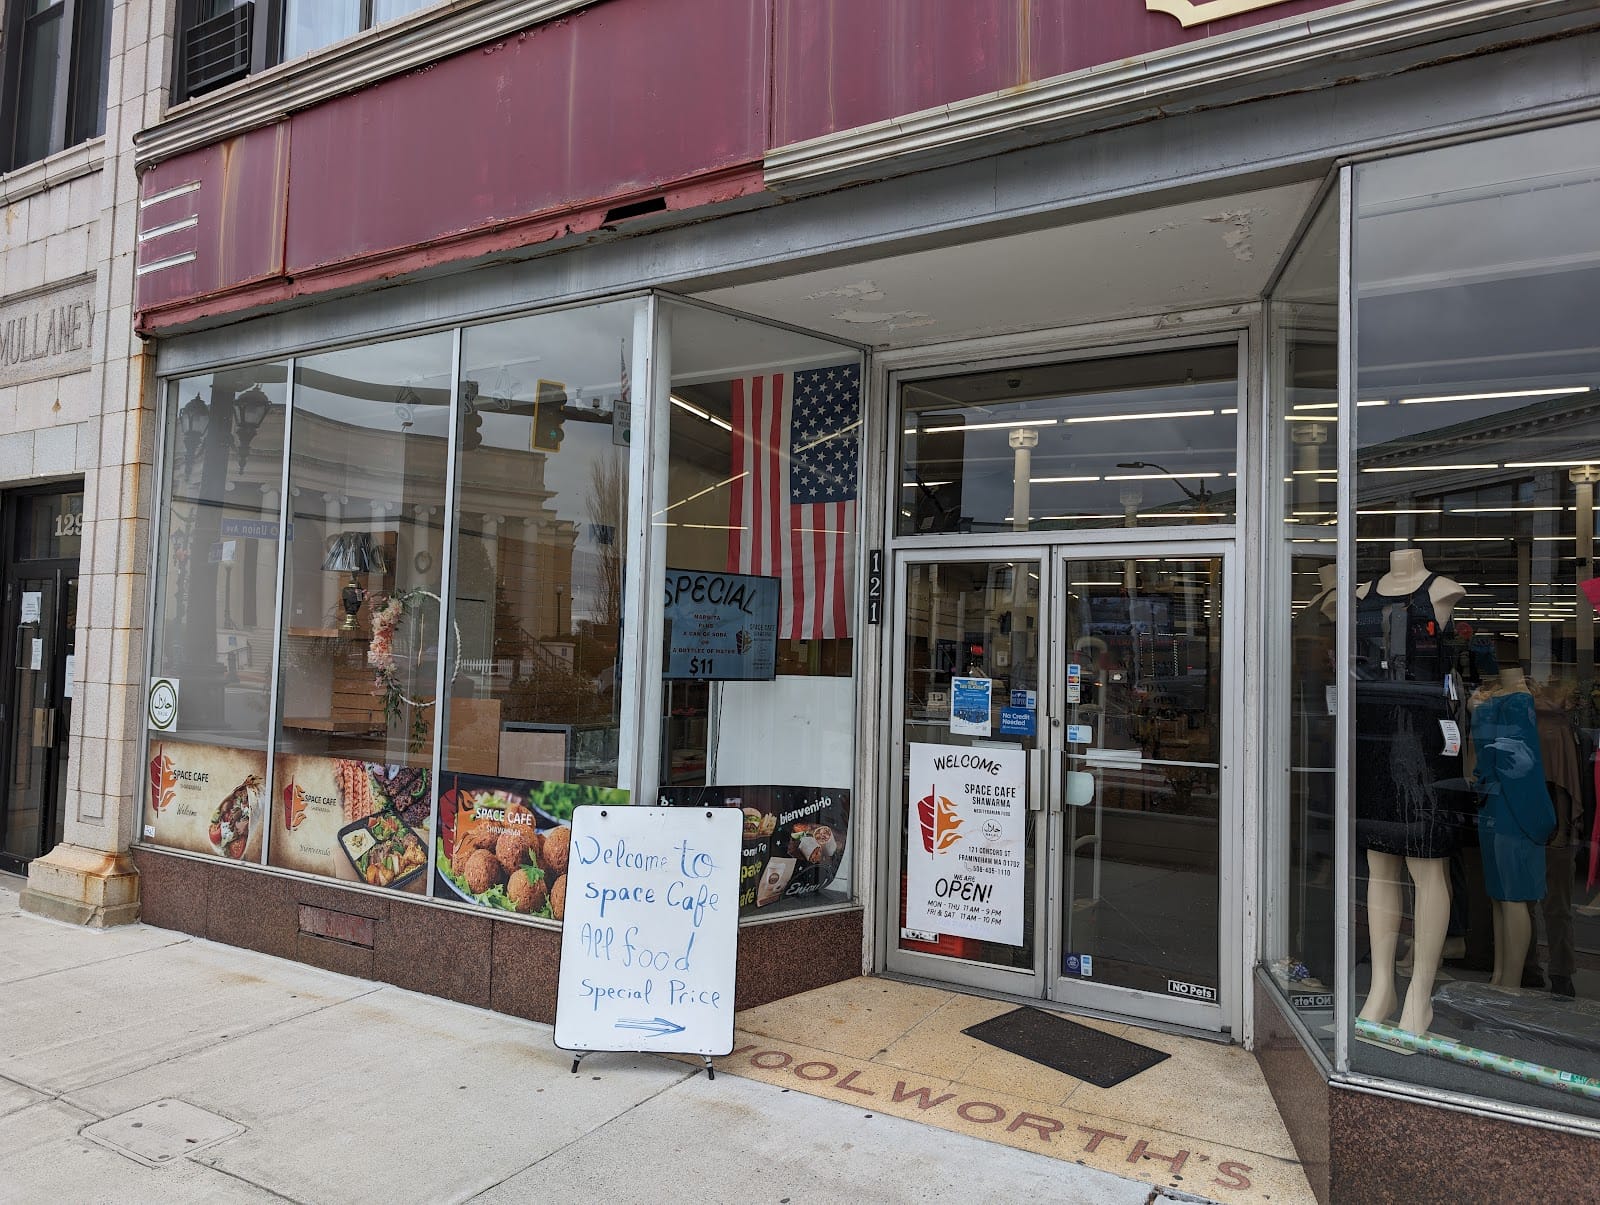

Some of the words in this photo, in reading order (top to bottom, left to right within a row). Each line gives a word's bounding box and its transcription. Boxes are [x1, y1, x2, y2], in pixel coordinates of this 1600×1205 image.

[664, 575, 756, 615] SPECIAL
[689, 655, 713, 677] $11
[933, 754, 1002, 776] WELCOME
[174, 769, 192, 781] SPACE
[193, 772, 209, 783] CAFE
[964, 783, 992, 796] SPACE
[994, 786, 1016, 798] CAFE
[305, 794, 322, 804] SPACE
[322, 797, 337, 807] CAFE
[972, 796, 1011, 808] SHAWARMA
[475, 807, 505, 822] SPACE
[507, 811, 533, 826] CAFE
[780, 797, 832, 826] bienvenido
[574, 836, 669, 872] Welcome
[673, 839, 721, 879] to
[958, 854, 993, 865] FRAMINGHAM
[993, 858, 1002, 866] MA
[979, 847, 1003, 857] CONCORD
[963, 875, 976, 883] ARE
[935, 878, 993, 904] OPEN!
[667, 881, 719, 928] Cafe
[927, 900, 942, 908] MON
[948, 902, 961, 911] THU
[943, 910, 956, 918] SAT
[581, 922, 614, 961] All
[579, 978, 652, 1012] Special
[670, 979, 721, 1009] Price
[1172, 982, 1189, 994] NO
[1190, 986, 1212, 998] Pets
[731, 1044, 1253, 1190] OOLWORTH'S
